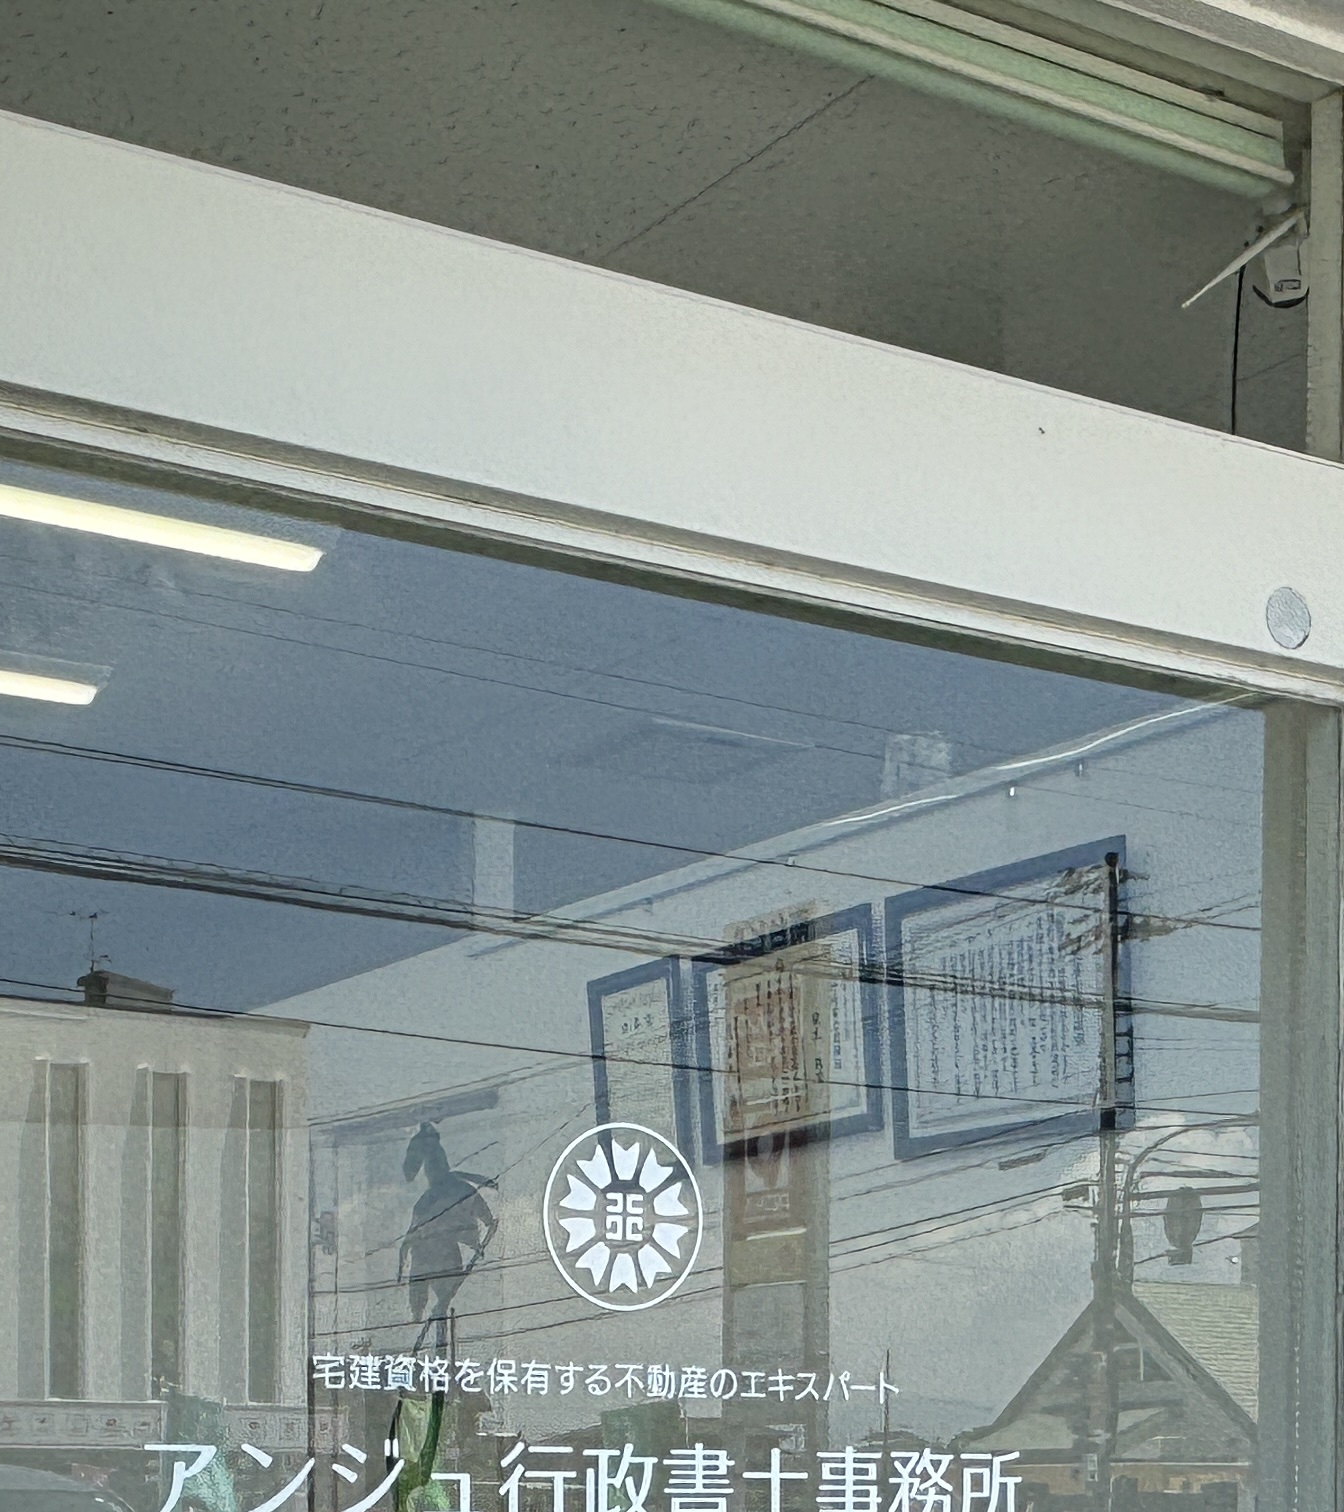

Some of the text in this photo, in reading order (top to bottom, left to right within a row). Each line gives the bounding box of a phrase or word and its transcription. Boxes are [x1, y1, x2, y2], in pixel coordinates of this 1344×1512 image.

[312, 1353, 900, 1404] 宅建資格を保有する不動産のエキスパート
